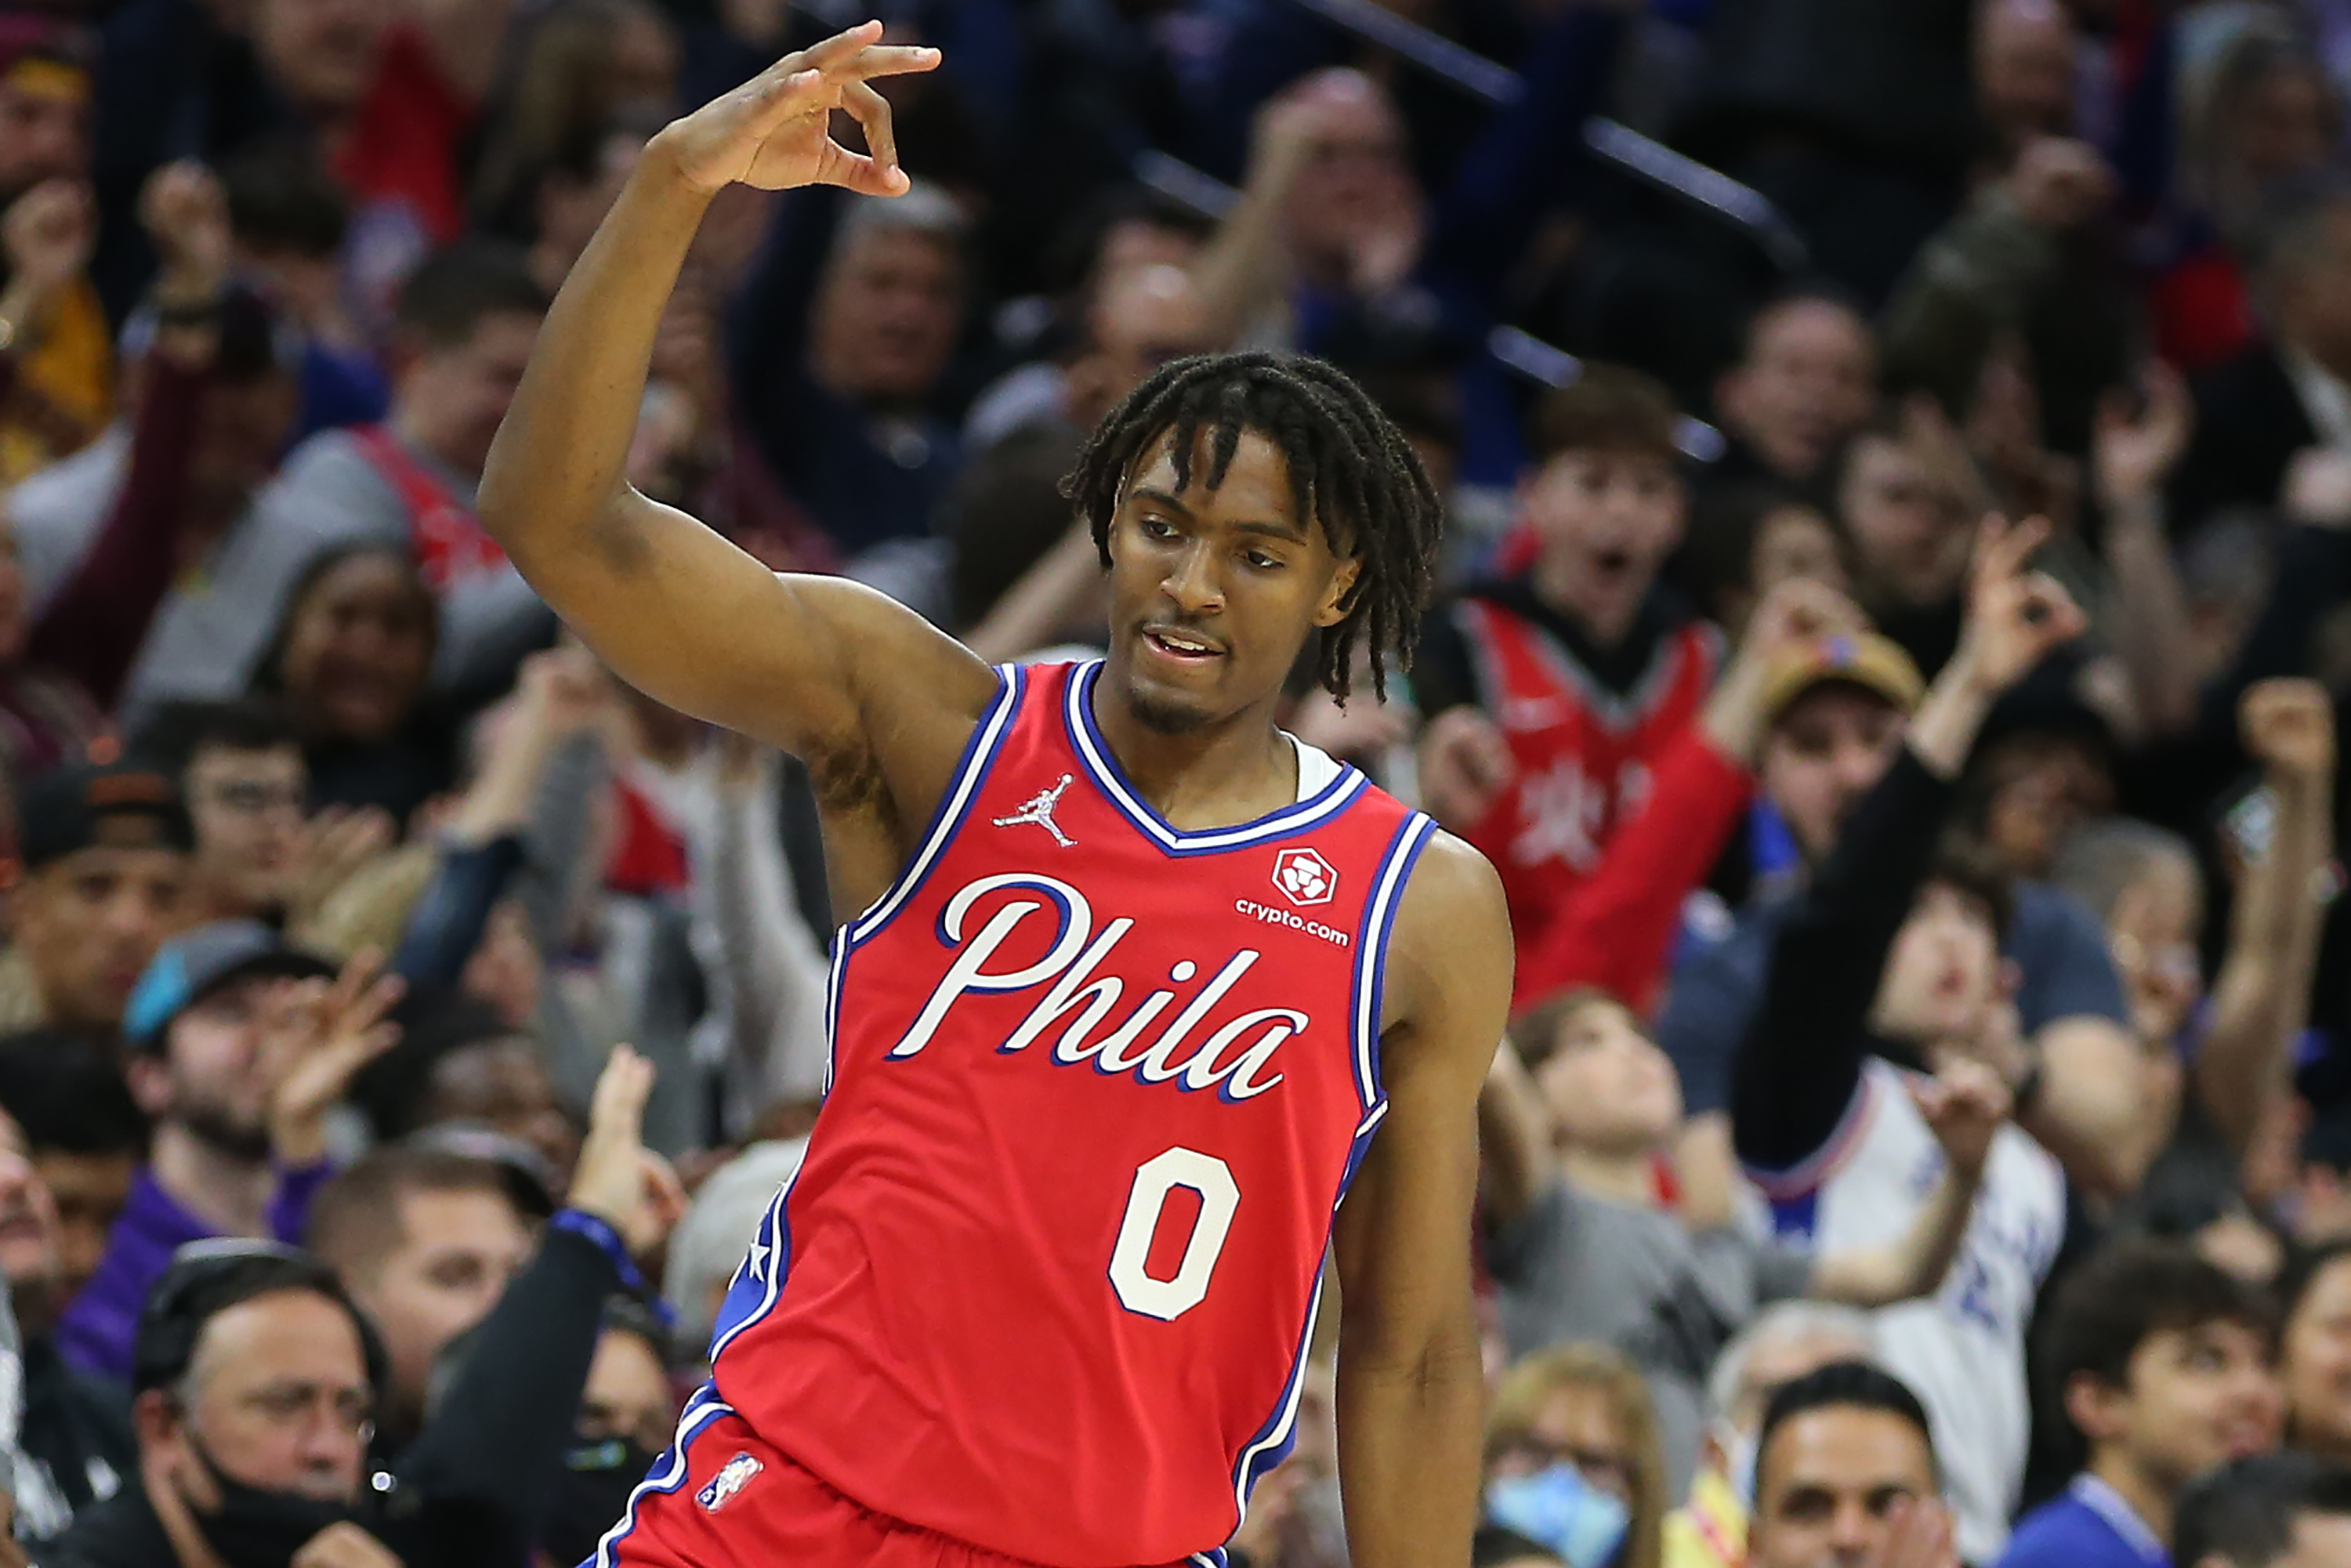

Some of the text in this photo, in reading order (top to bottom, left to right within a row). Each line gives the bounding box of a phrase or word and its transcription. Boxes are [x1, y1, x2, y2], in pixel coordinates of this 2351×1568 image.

[885, 872, 1310, 1103] Phila
[1235, 899, 1349, 947] crypto.com
[1107, 1145, 1241, 1321] 0
